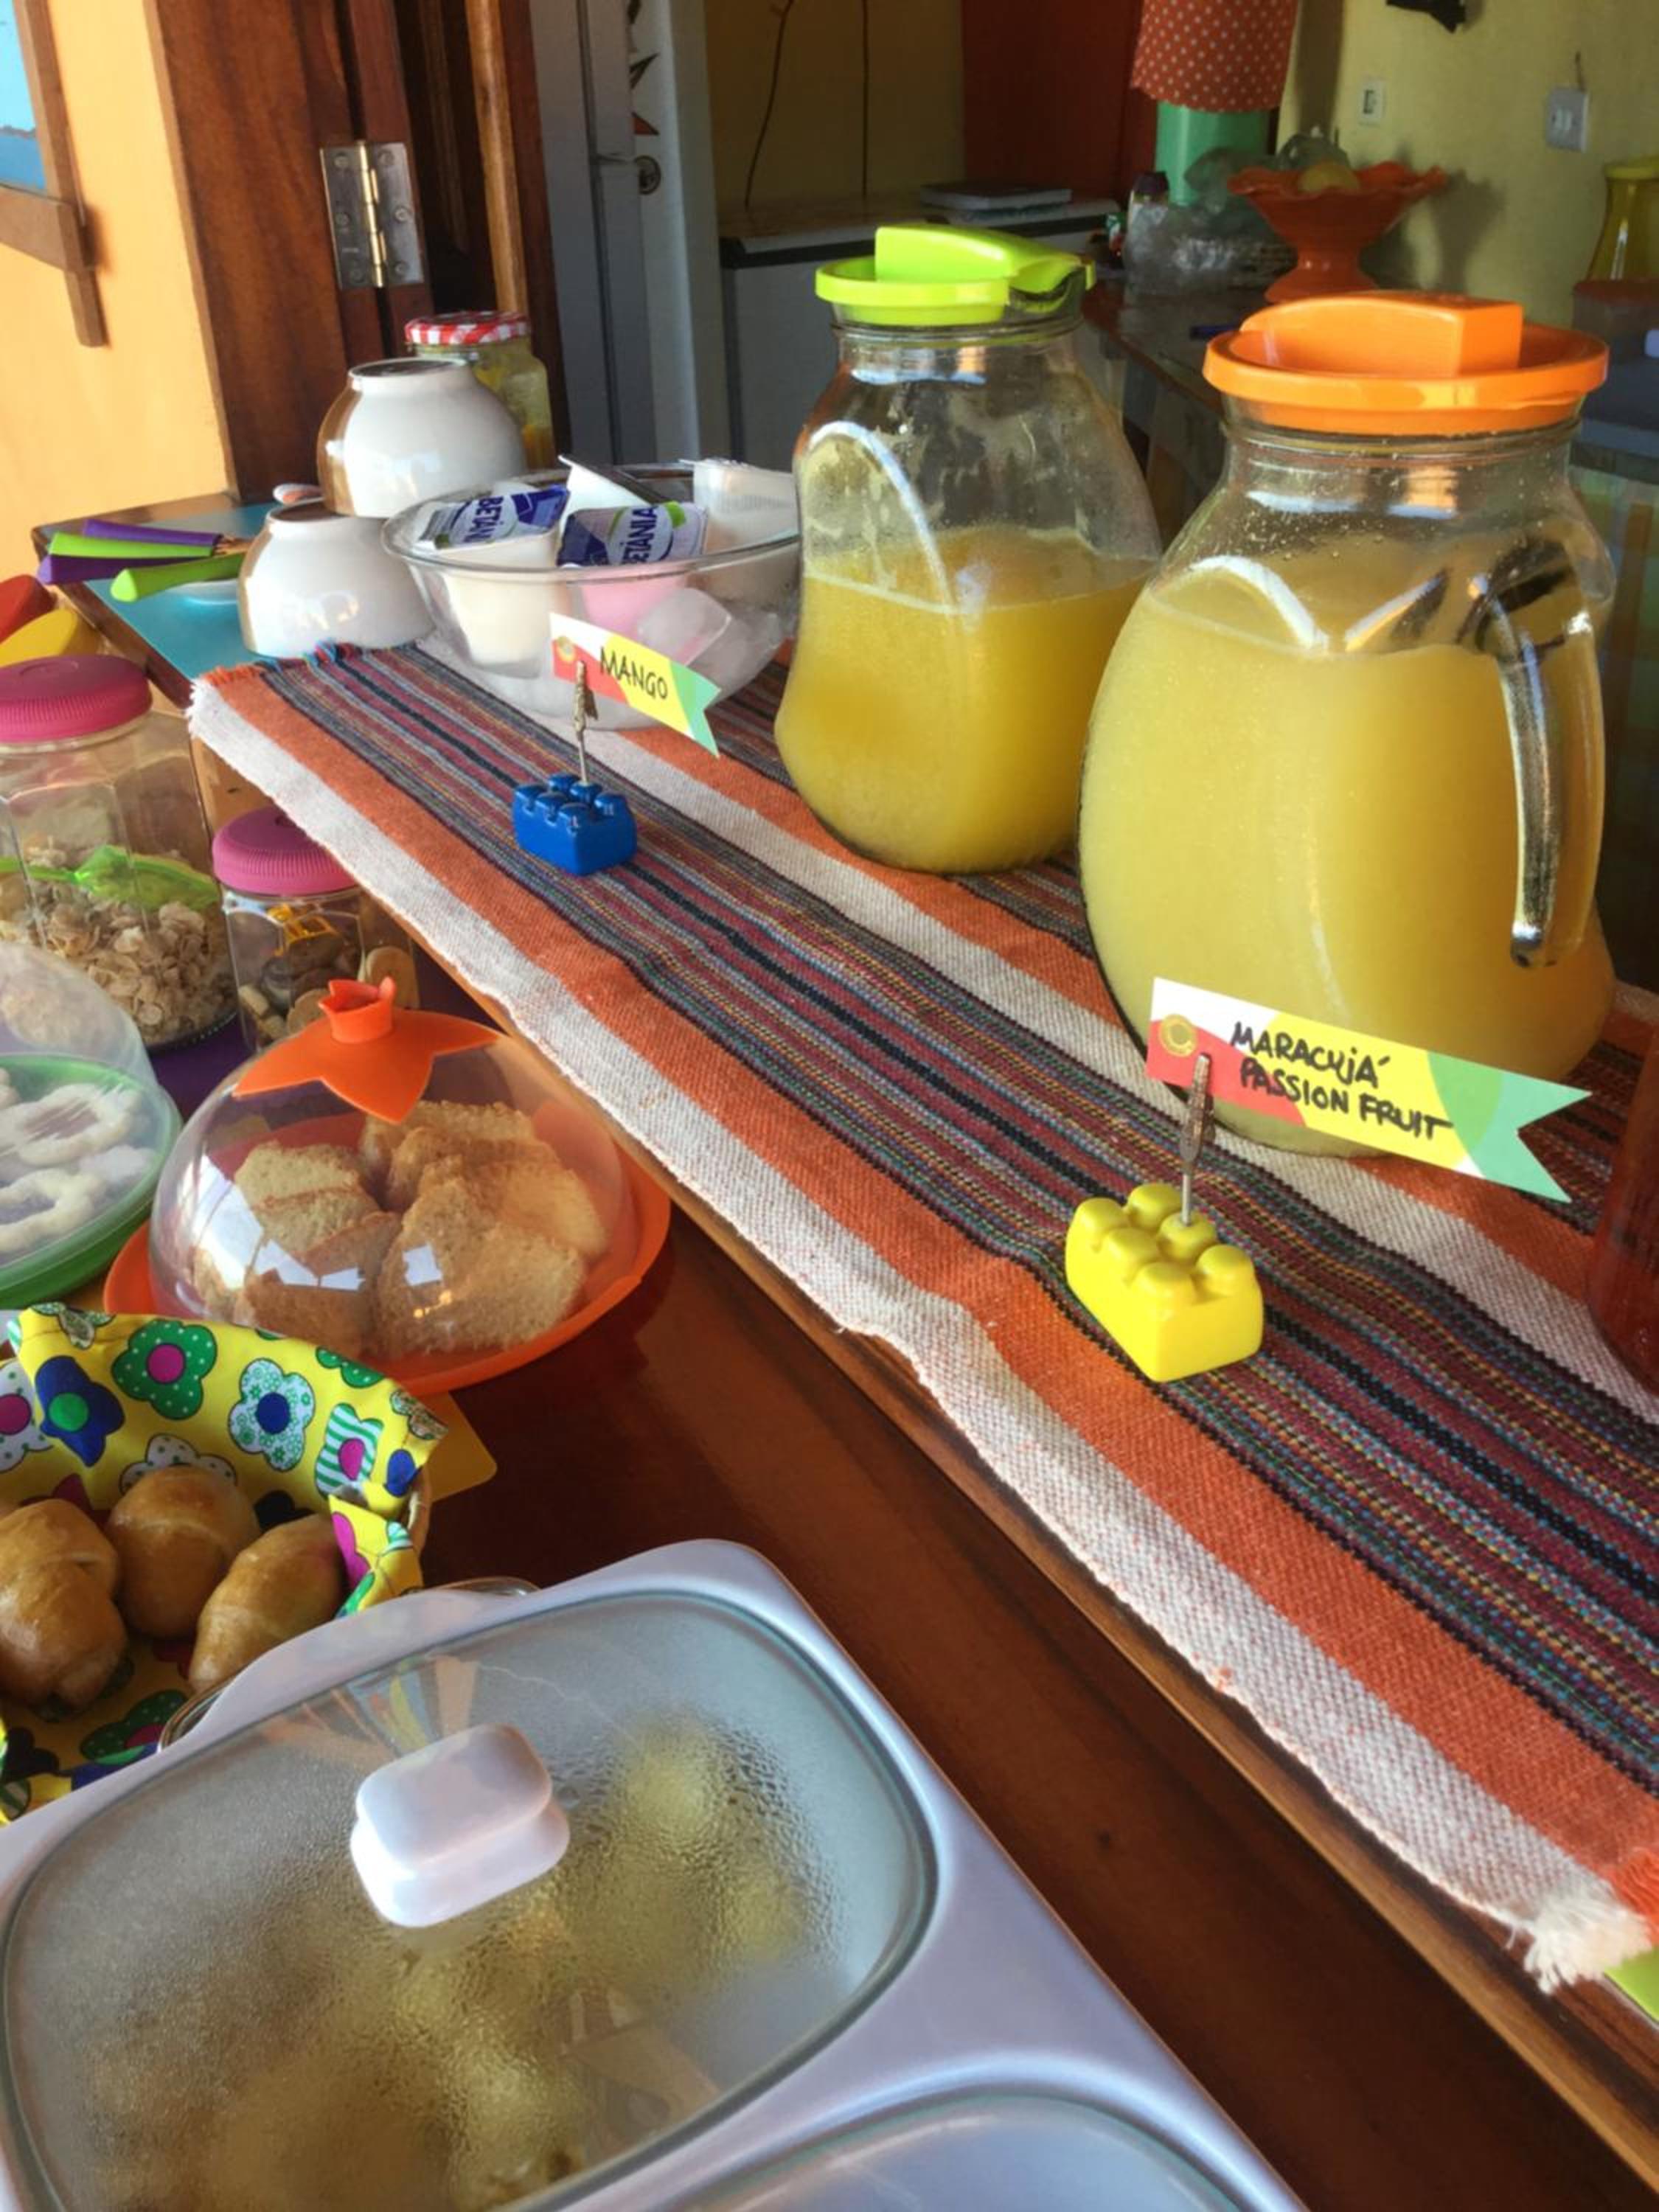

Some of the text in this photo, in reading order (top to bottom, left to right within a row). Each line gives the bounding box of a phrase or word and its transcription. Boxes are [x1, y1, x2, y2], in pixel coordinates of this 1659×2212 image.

[599, 646, 668, 700] MANGO
[1240, 1056, 1454, 1140] PASSION FRUIT
